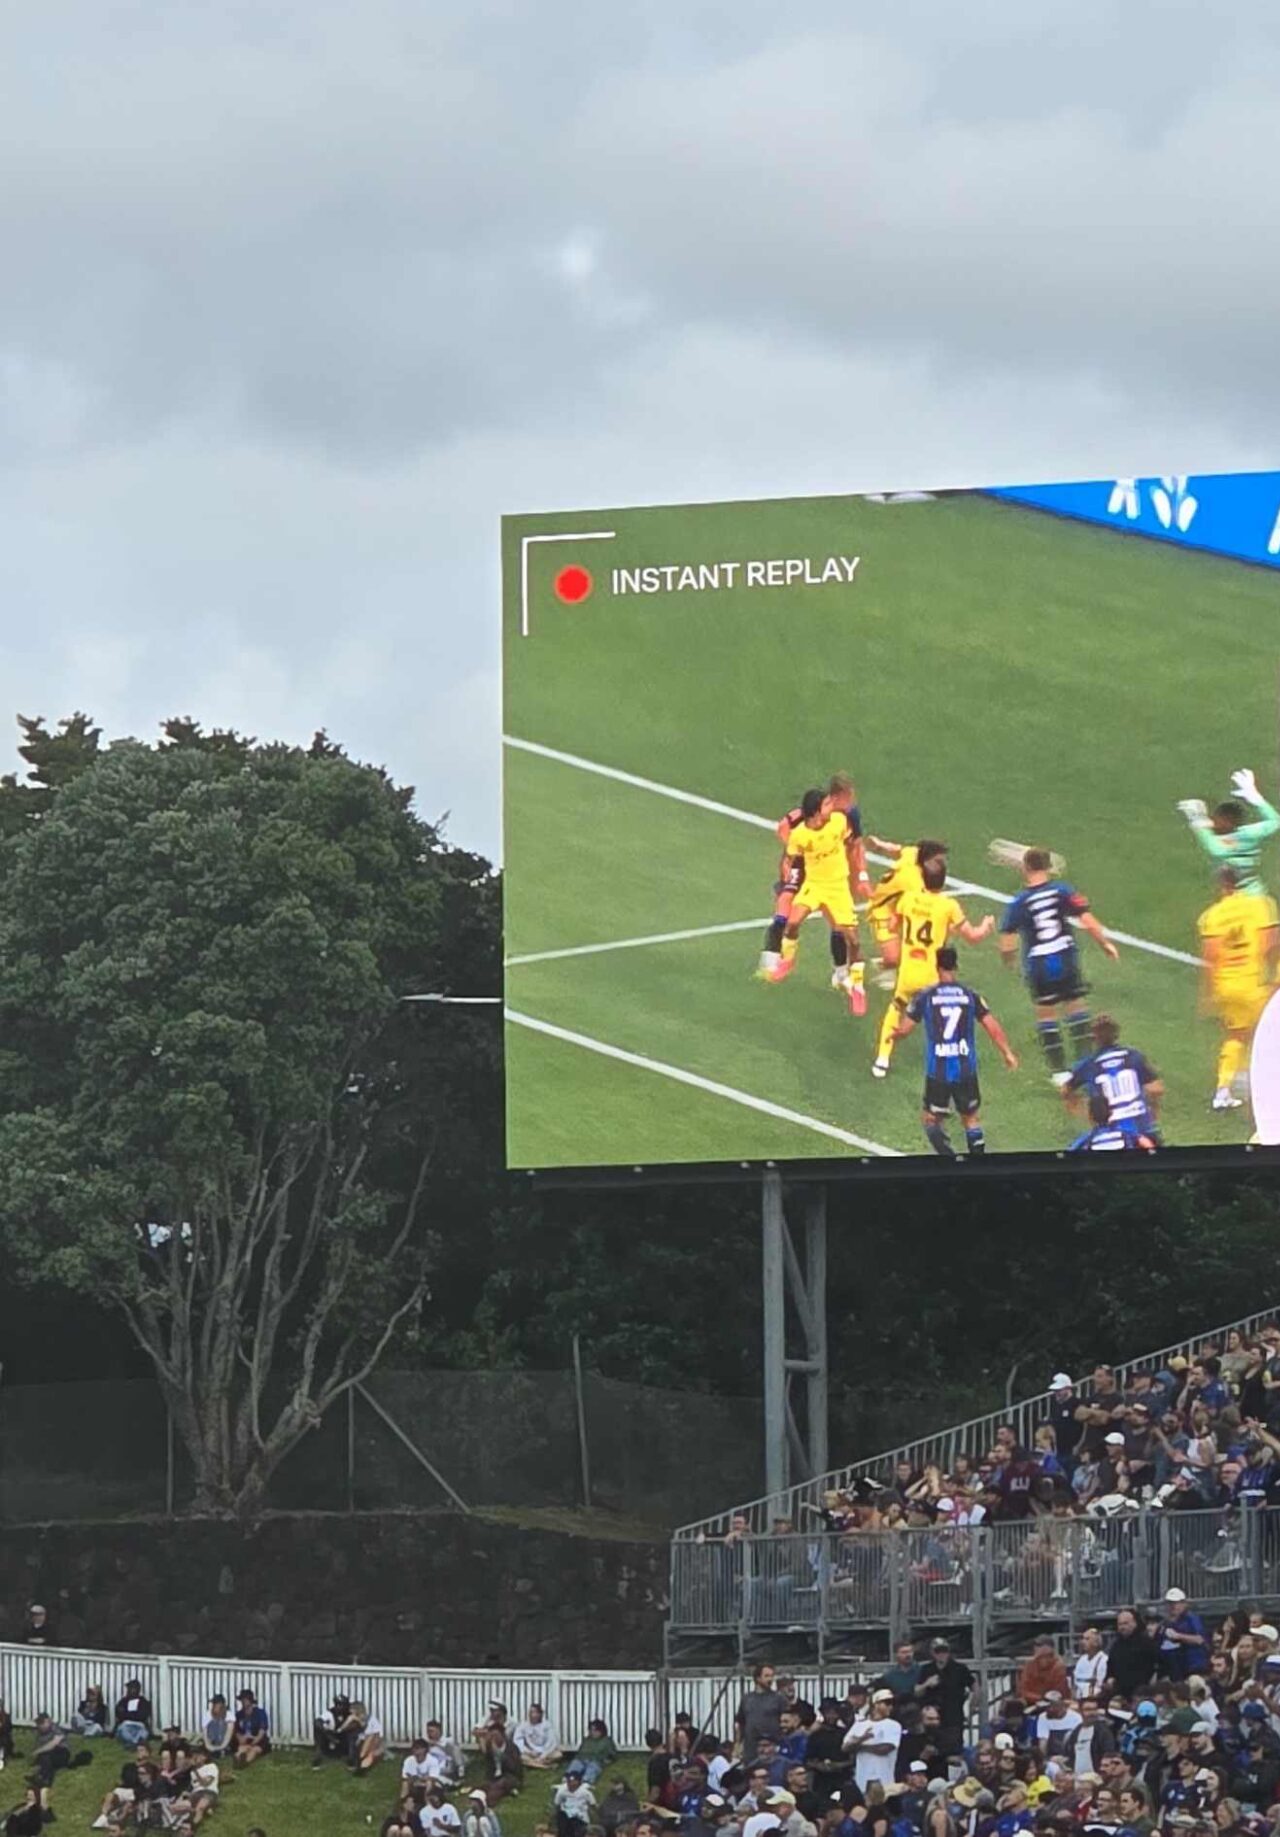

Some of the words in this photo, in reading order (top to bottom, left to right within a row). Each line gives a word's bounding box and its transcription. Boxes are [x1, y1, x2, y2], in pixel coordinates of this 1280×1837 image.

[612, 563, 740, 595] INSTANT
[747, 557, 860, 587] REPLAY
[904, 916, 933, 947] 14
[940, 1006, 962, 1040] 7
